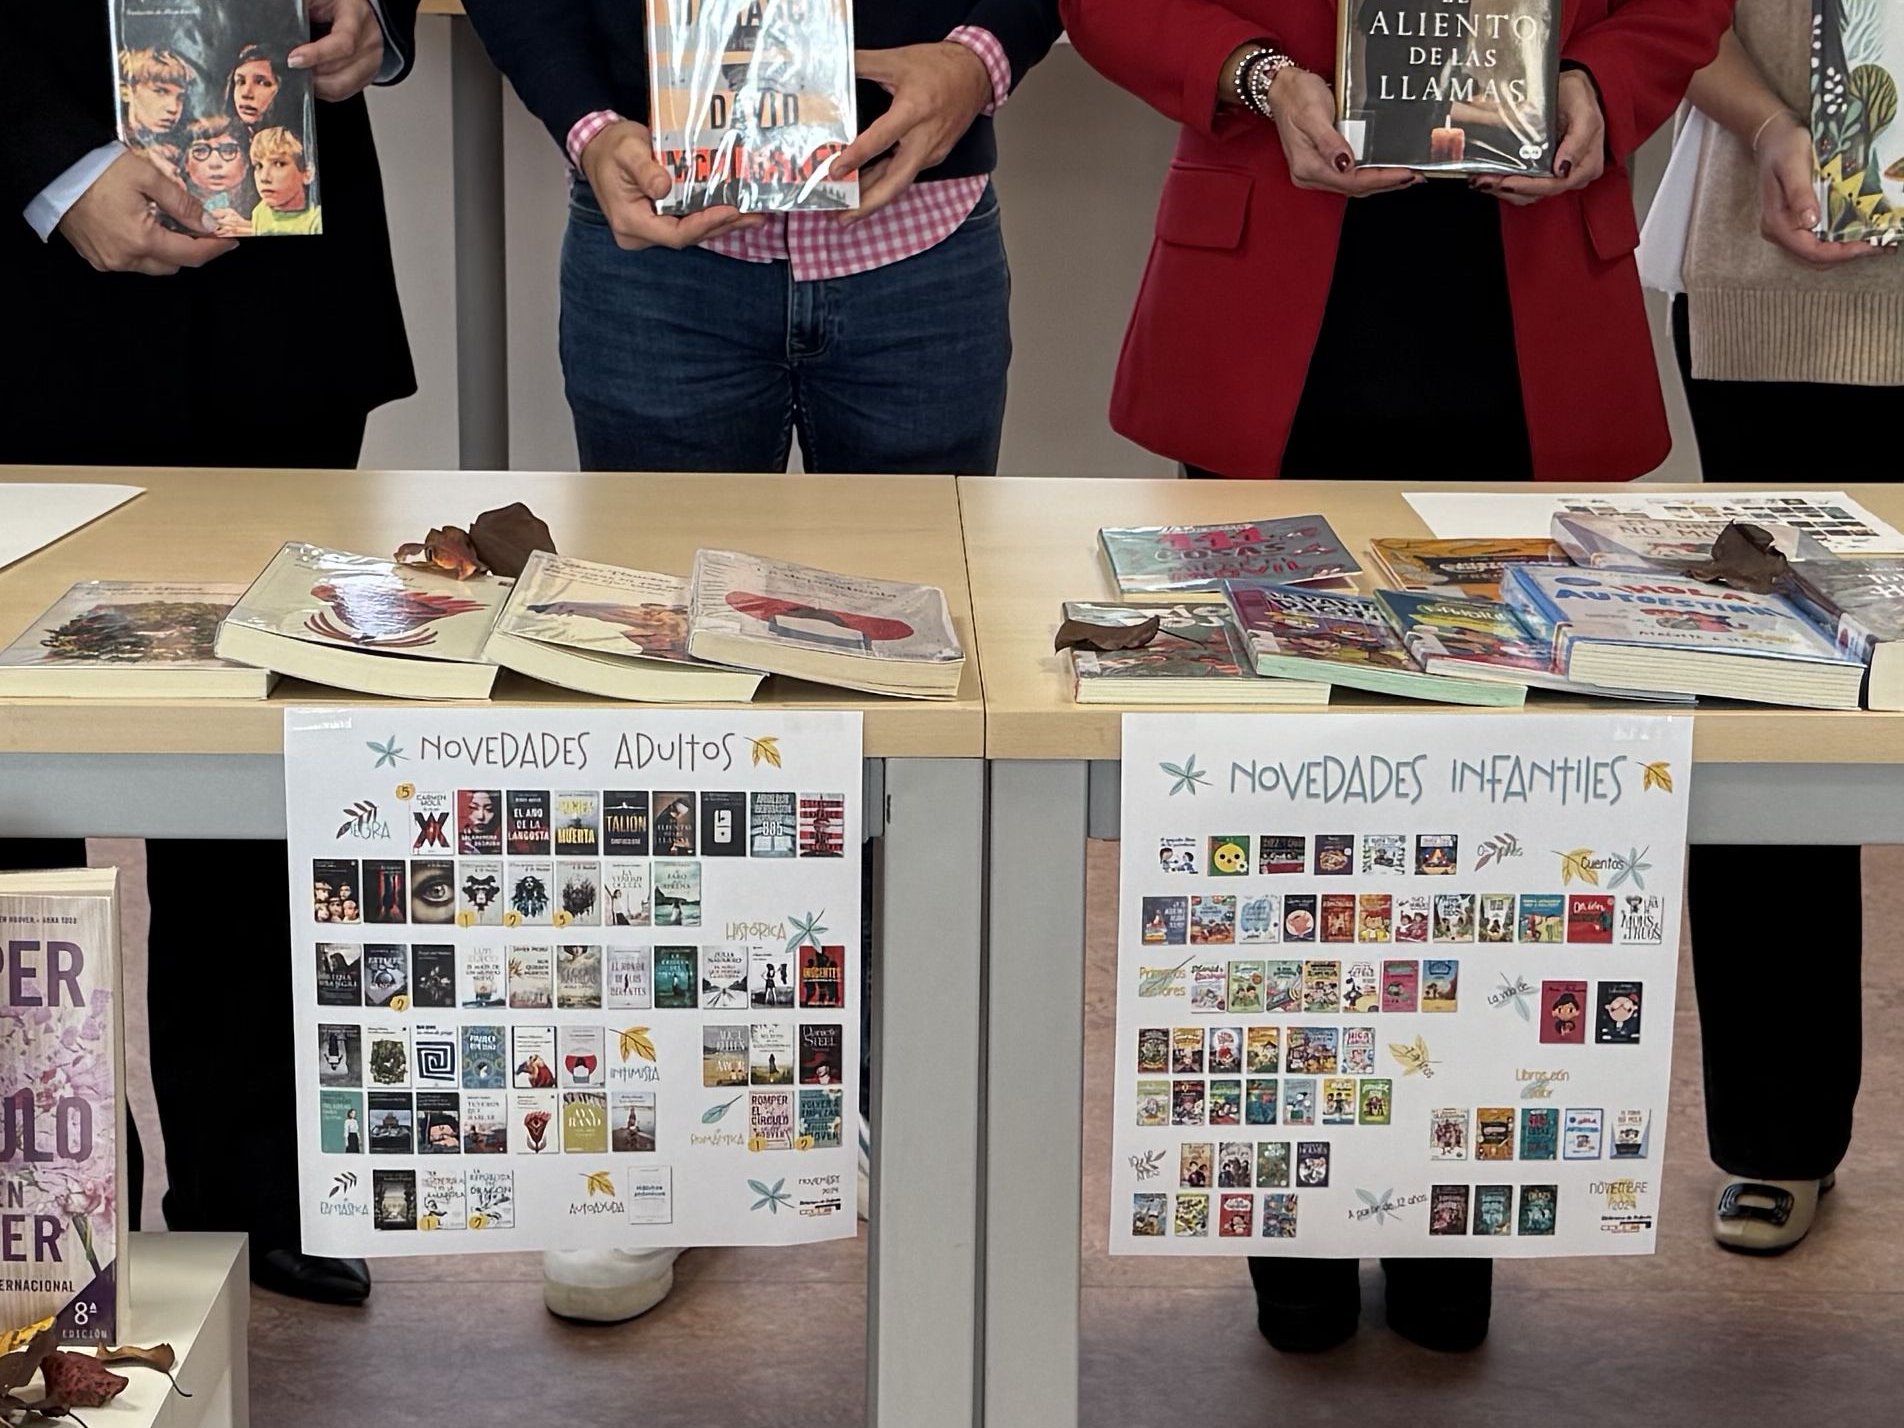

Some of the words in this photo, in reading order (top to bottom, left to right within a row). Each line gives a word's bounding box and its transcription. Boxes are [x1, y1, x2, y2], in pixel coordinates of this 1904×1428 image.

[1369, 11, 1537, 40] ALIENTO
[1409, 47, 1442, 66] DE
[1451, 49, 1497, 67] LAS
[1380, 75, 1526, 103] LLAMAS
[420, 732, 590, 770] NOVEDADES
[1230, 754, 1428, 805] NOVEDADES
[508, 830, 550, 841] LANGOSTA
[557, 828, 595, 844] MUERTA
[1581, 856, 1624, 870] Cuentos
[751, 1092, 788, 1105] ROMPER
[62, 1327, 109, 1339] EDICIÓN
